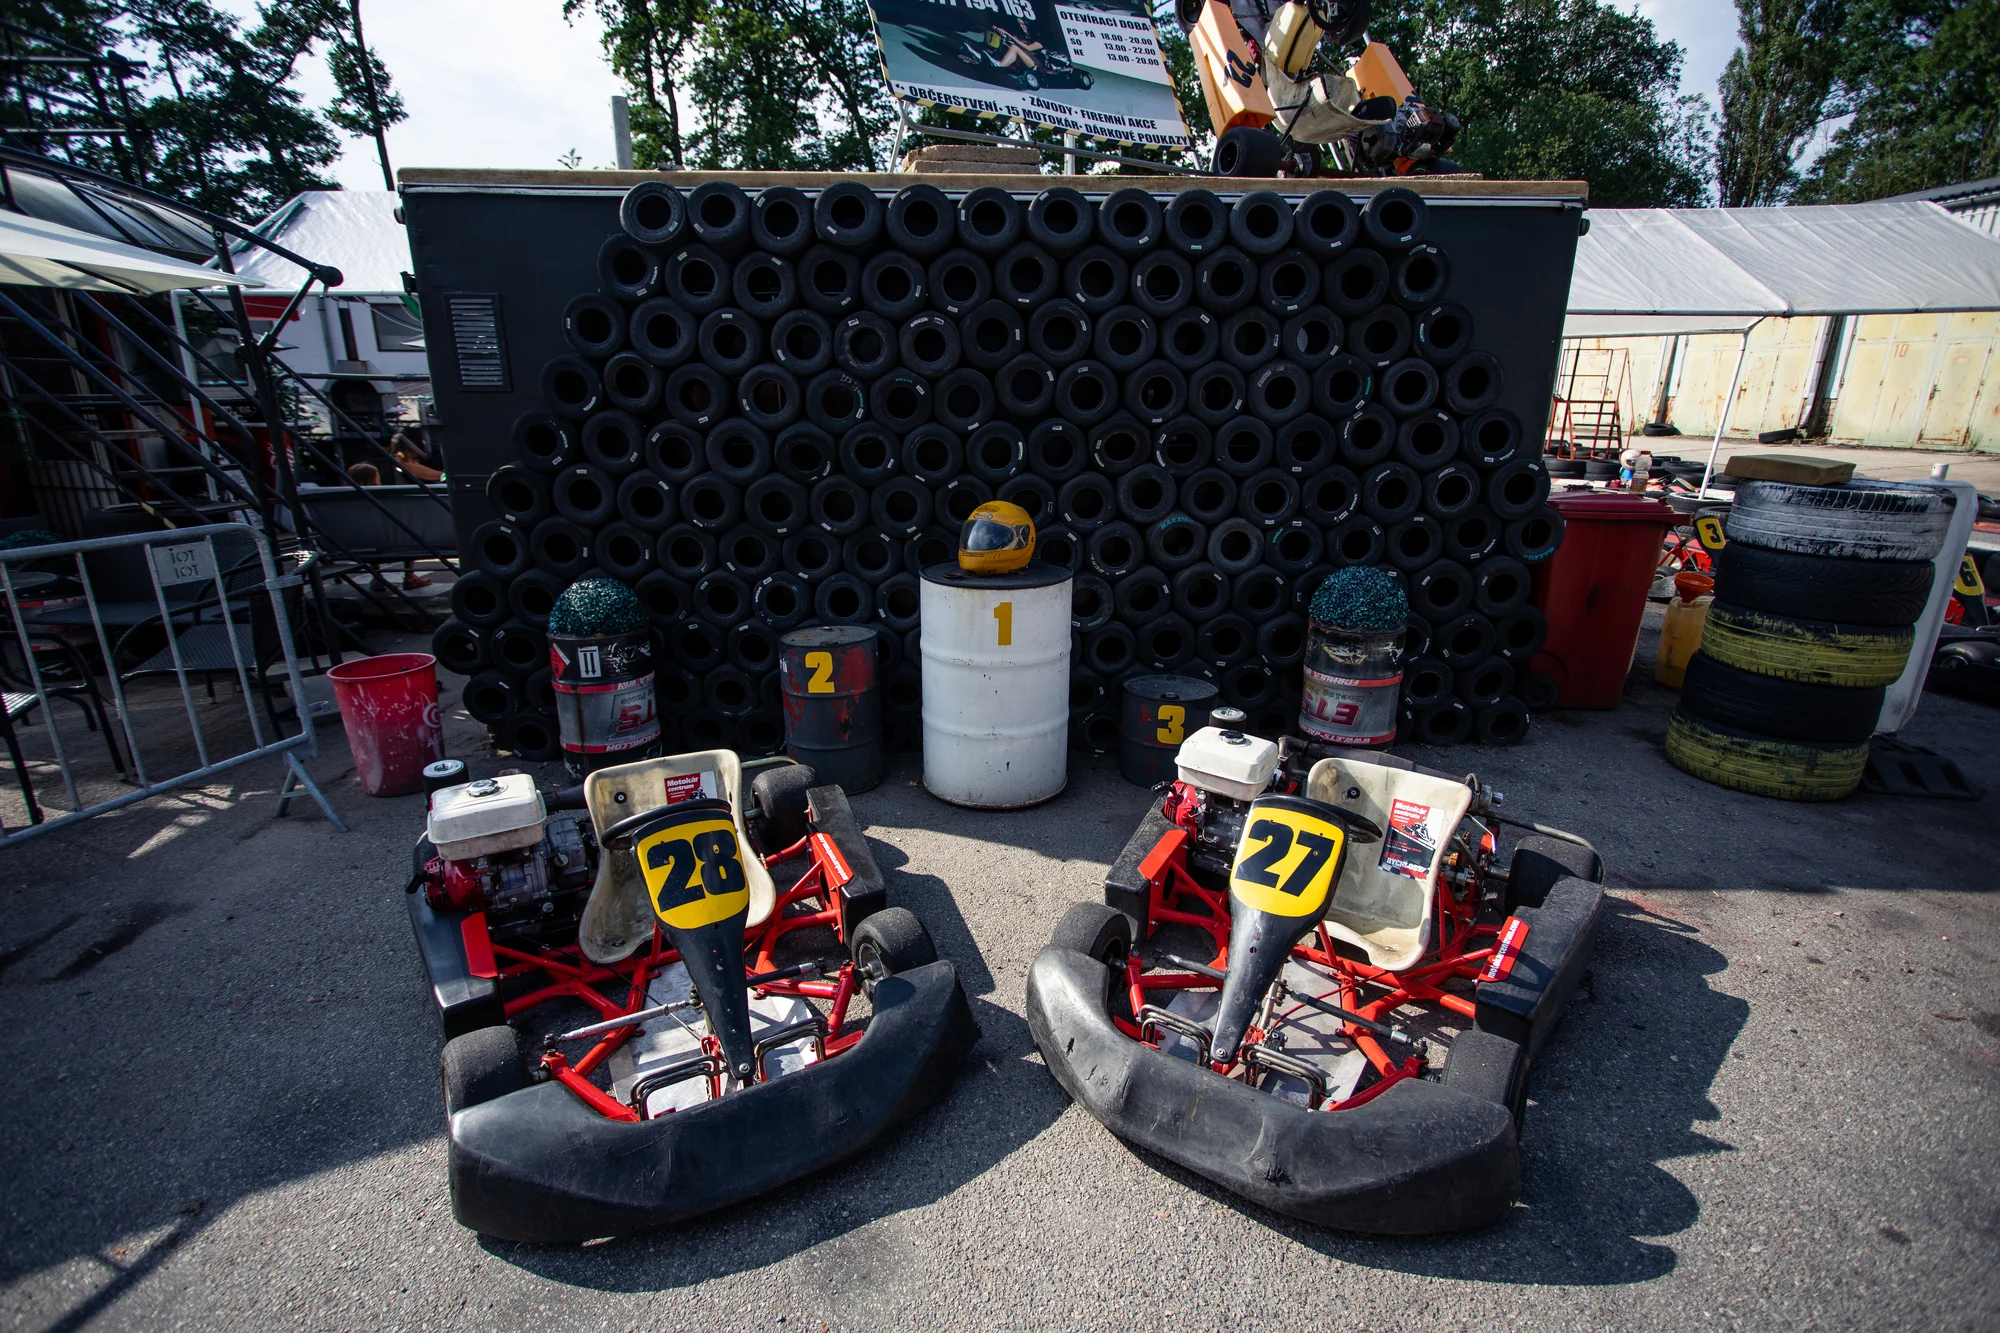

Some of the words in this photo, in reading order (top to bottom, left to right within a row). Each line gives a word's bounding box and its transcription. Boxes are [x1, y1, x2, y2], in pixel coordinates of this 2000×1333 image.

[1001, 0, 1036, 21] 163
[1060, 11, 1118, 28] OTEVÍRACÍ
[1119, 19, 1152, 32] DOBA:
[1066, 27, 1078, 36] PO
[1129, 36, 1153, 46] 20.00
[1070, 38, 1082, 46] SO
[1132, 46, 1156, 56] 22.00
[1073, 48, 1085, 56] NE
[1136, 57, 1160, 66] 20.00
[908, 85, 998, 113] OBČERSTVENÍ
[1004, 105, 1020, 117] 15
[1022, 108, 1080, 131] MOTOKÁR
[1085, 123, 1137, 142] DÁRKOVÉ
[1137, 132, 1189, 146] POUKAZY
[1029, 95, 1074, 116] ZÁVODY
[1080, 109, 1127, 126] FIREMNÍ
[1128, 117, 1158, 130] AKCE
[1706, 523, 1721, 543] 3
[993, 602, 1012, 646] 1
[805, 651, 835, 693] 2
[615, 700, 657, 732] TS
[1156, 705, 1186, 745] 3
[667, 776, 699, 787] Motokár
[668, 784, 695, 792] centrum
[1394, 809, 1420, 819] centrum
[1395, 802, 1428, 814] Motokár
[1234, 819, 1335, 897] 27
[647, 829, 746, 913] 28
